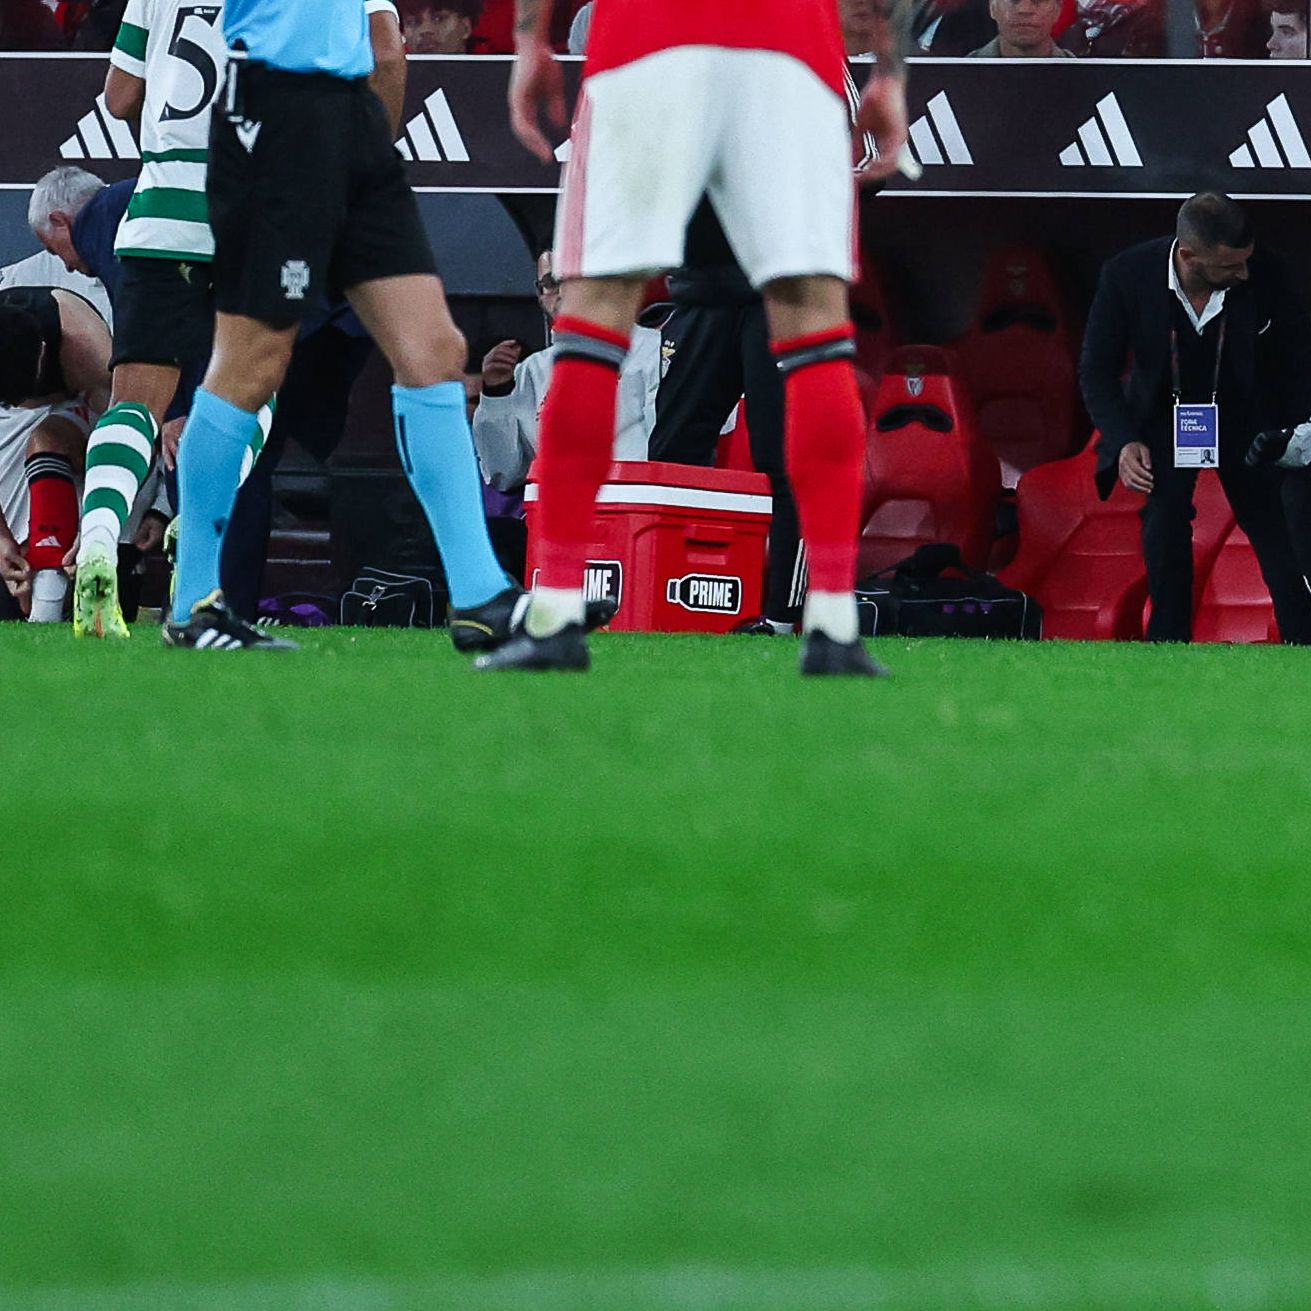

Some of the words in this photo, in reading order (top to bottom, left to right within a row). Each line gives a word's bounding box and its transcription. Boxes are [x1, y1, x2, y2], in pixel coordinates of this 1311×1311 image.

[158, 5, 222, 123] 5
[583, 568, 614, 601] IME
[689, 580, 733, 608] PRIME
